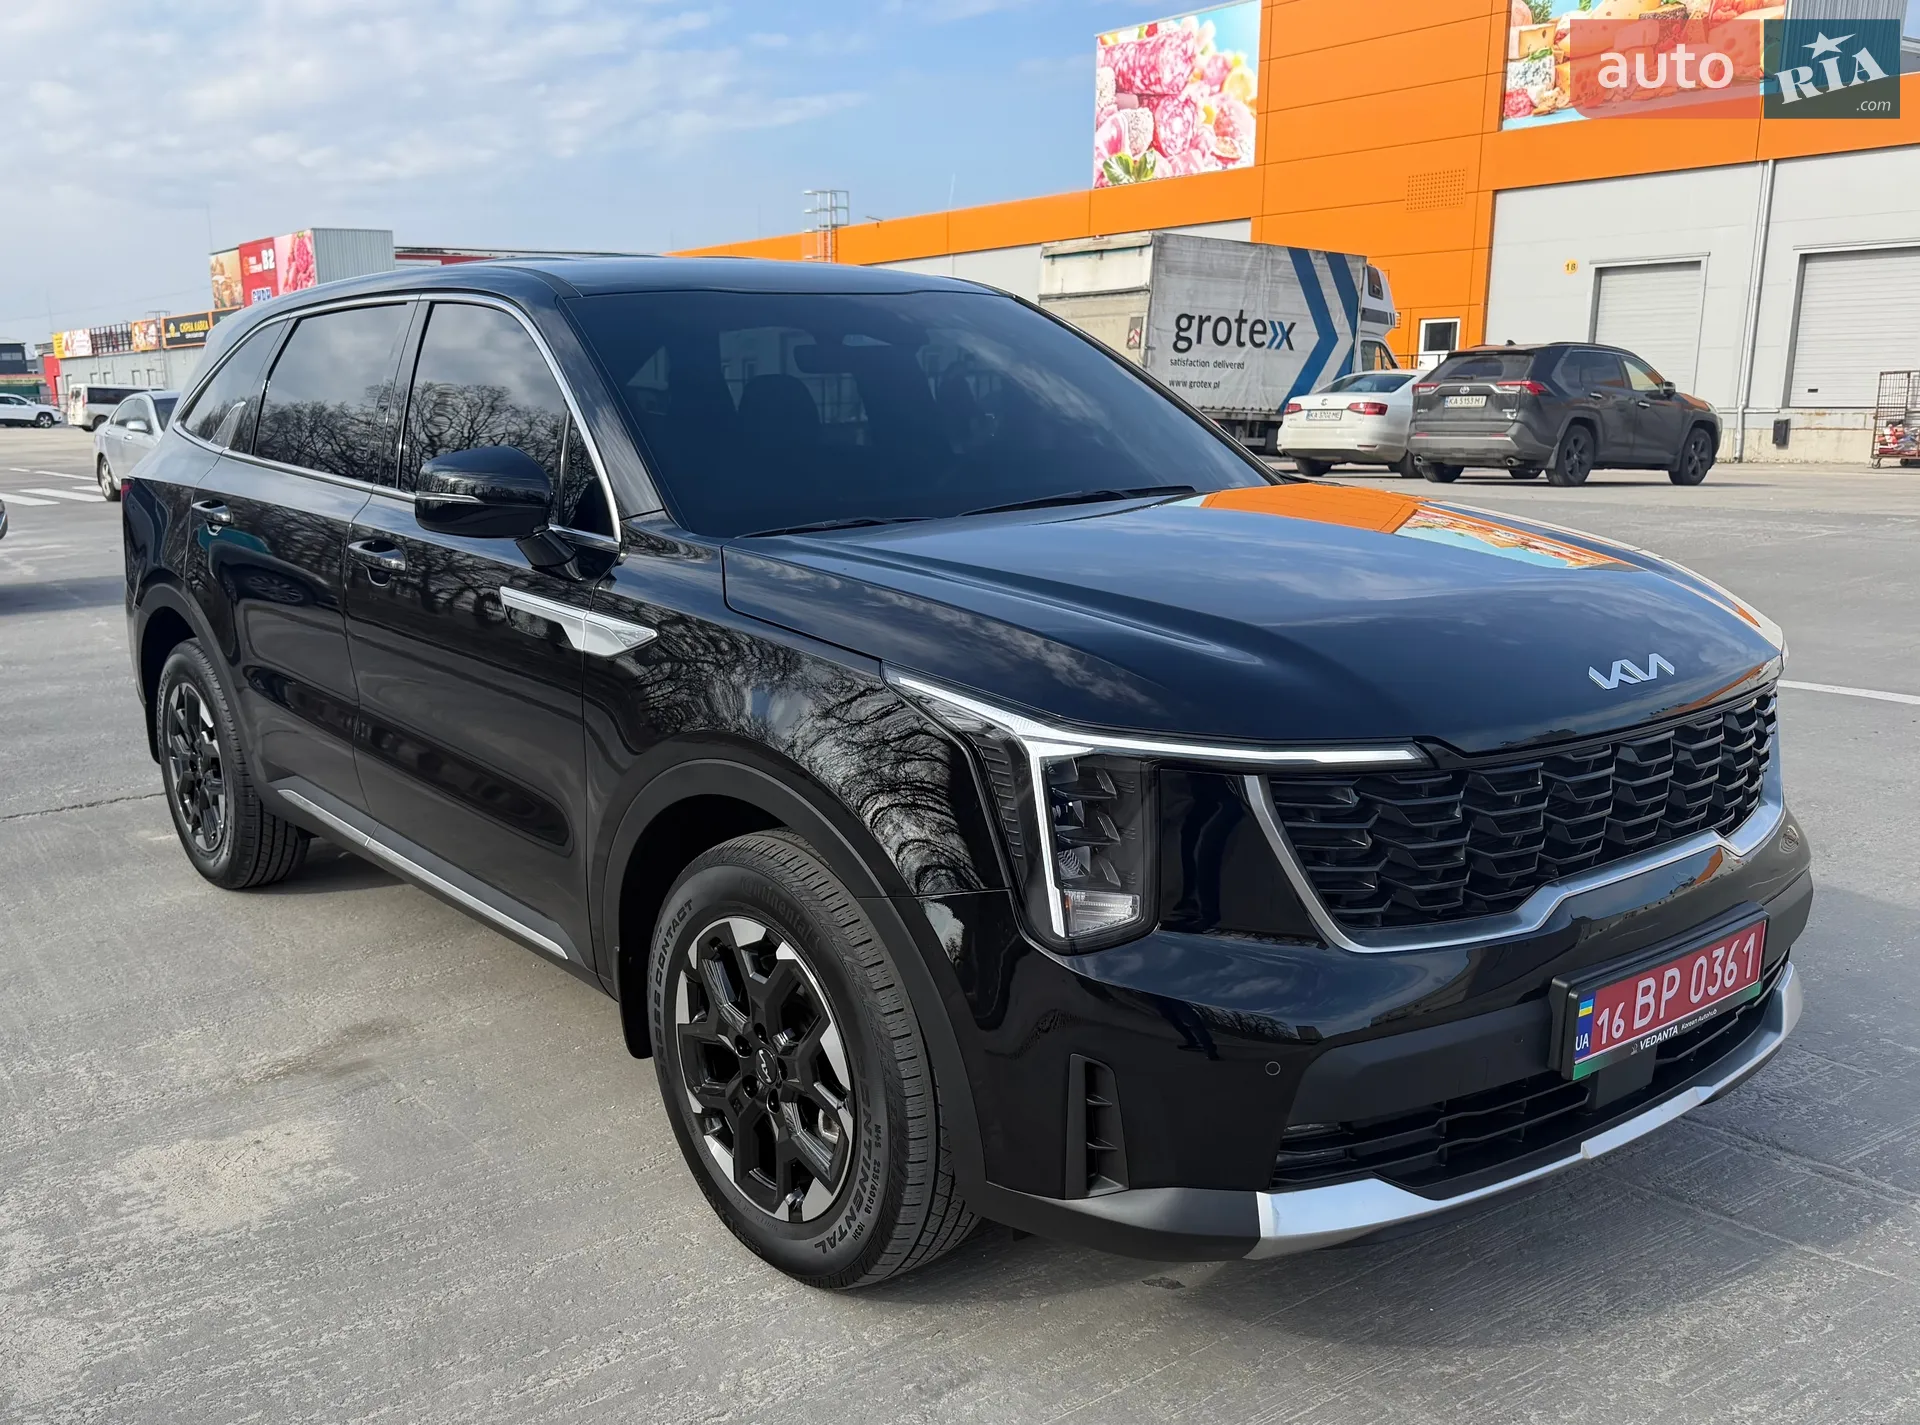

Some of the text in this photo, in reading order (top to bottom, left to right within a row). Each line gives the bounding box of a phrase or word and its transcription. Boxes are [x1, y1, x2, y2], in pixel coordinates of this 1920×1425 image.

[1172, 309, 1297, 354] grotex
[1170, 358, 1245, 370] satisfaction delivered
[1168, 379, 1220, 390] www.grotex.pl
[655, 899, 693, 984] CONTACT
[1597, 932, 1755, 1044] 16 BP 0361
[1575, 1033, 1589, 1050] UA
[1640, 1025, 1679, 1050] VEDANTA
[864, 1158, 881, 1215] 235/60R18
[851, 1221, 866, 1242] 103H
